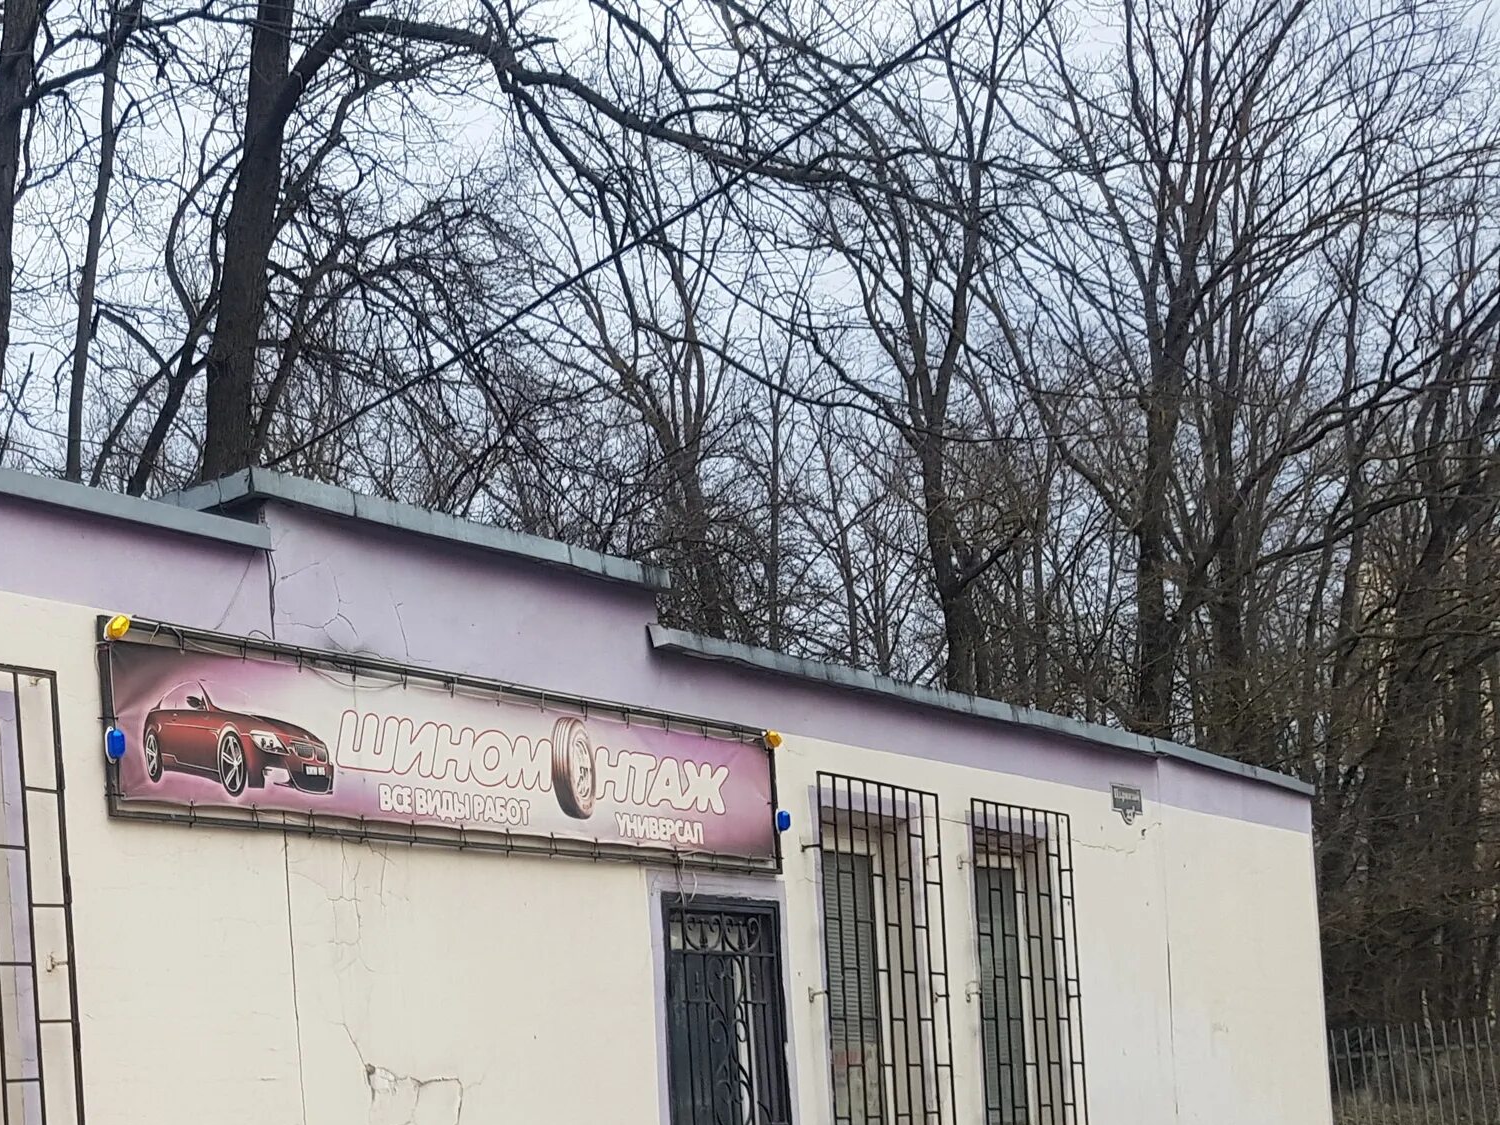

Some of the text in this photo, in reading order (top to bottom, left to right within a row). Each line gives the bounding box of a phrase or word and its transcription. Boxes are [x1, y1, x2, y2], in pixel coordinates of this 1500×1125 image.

[378, 784, 531, 826] ВСЕ ВИДЫ РАБОТ
[614, 811, 705, 845] УНИВЕРСАЛ
